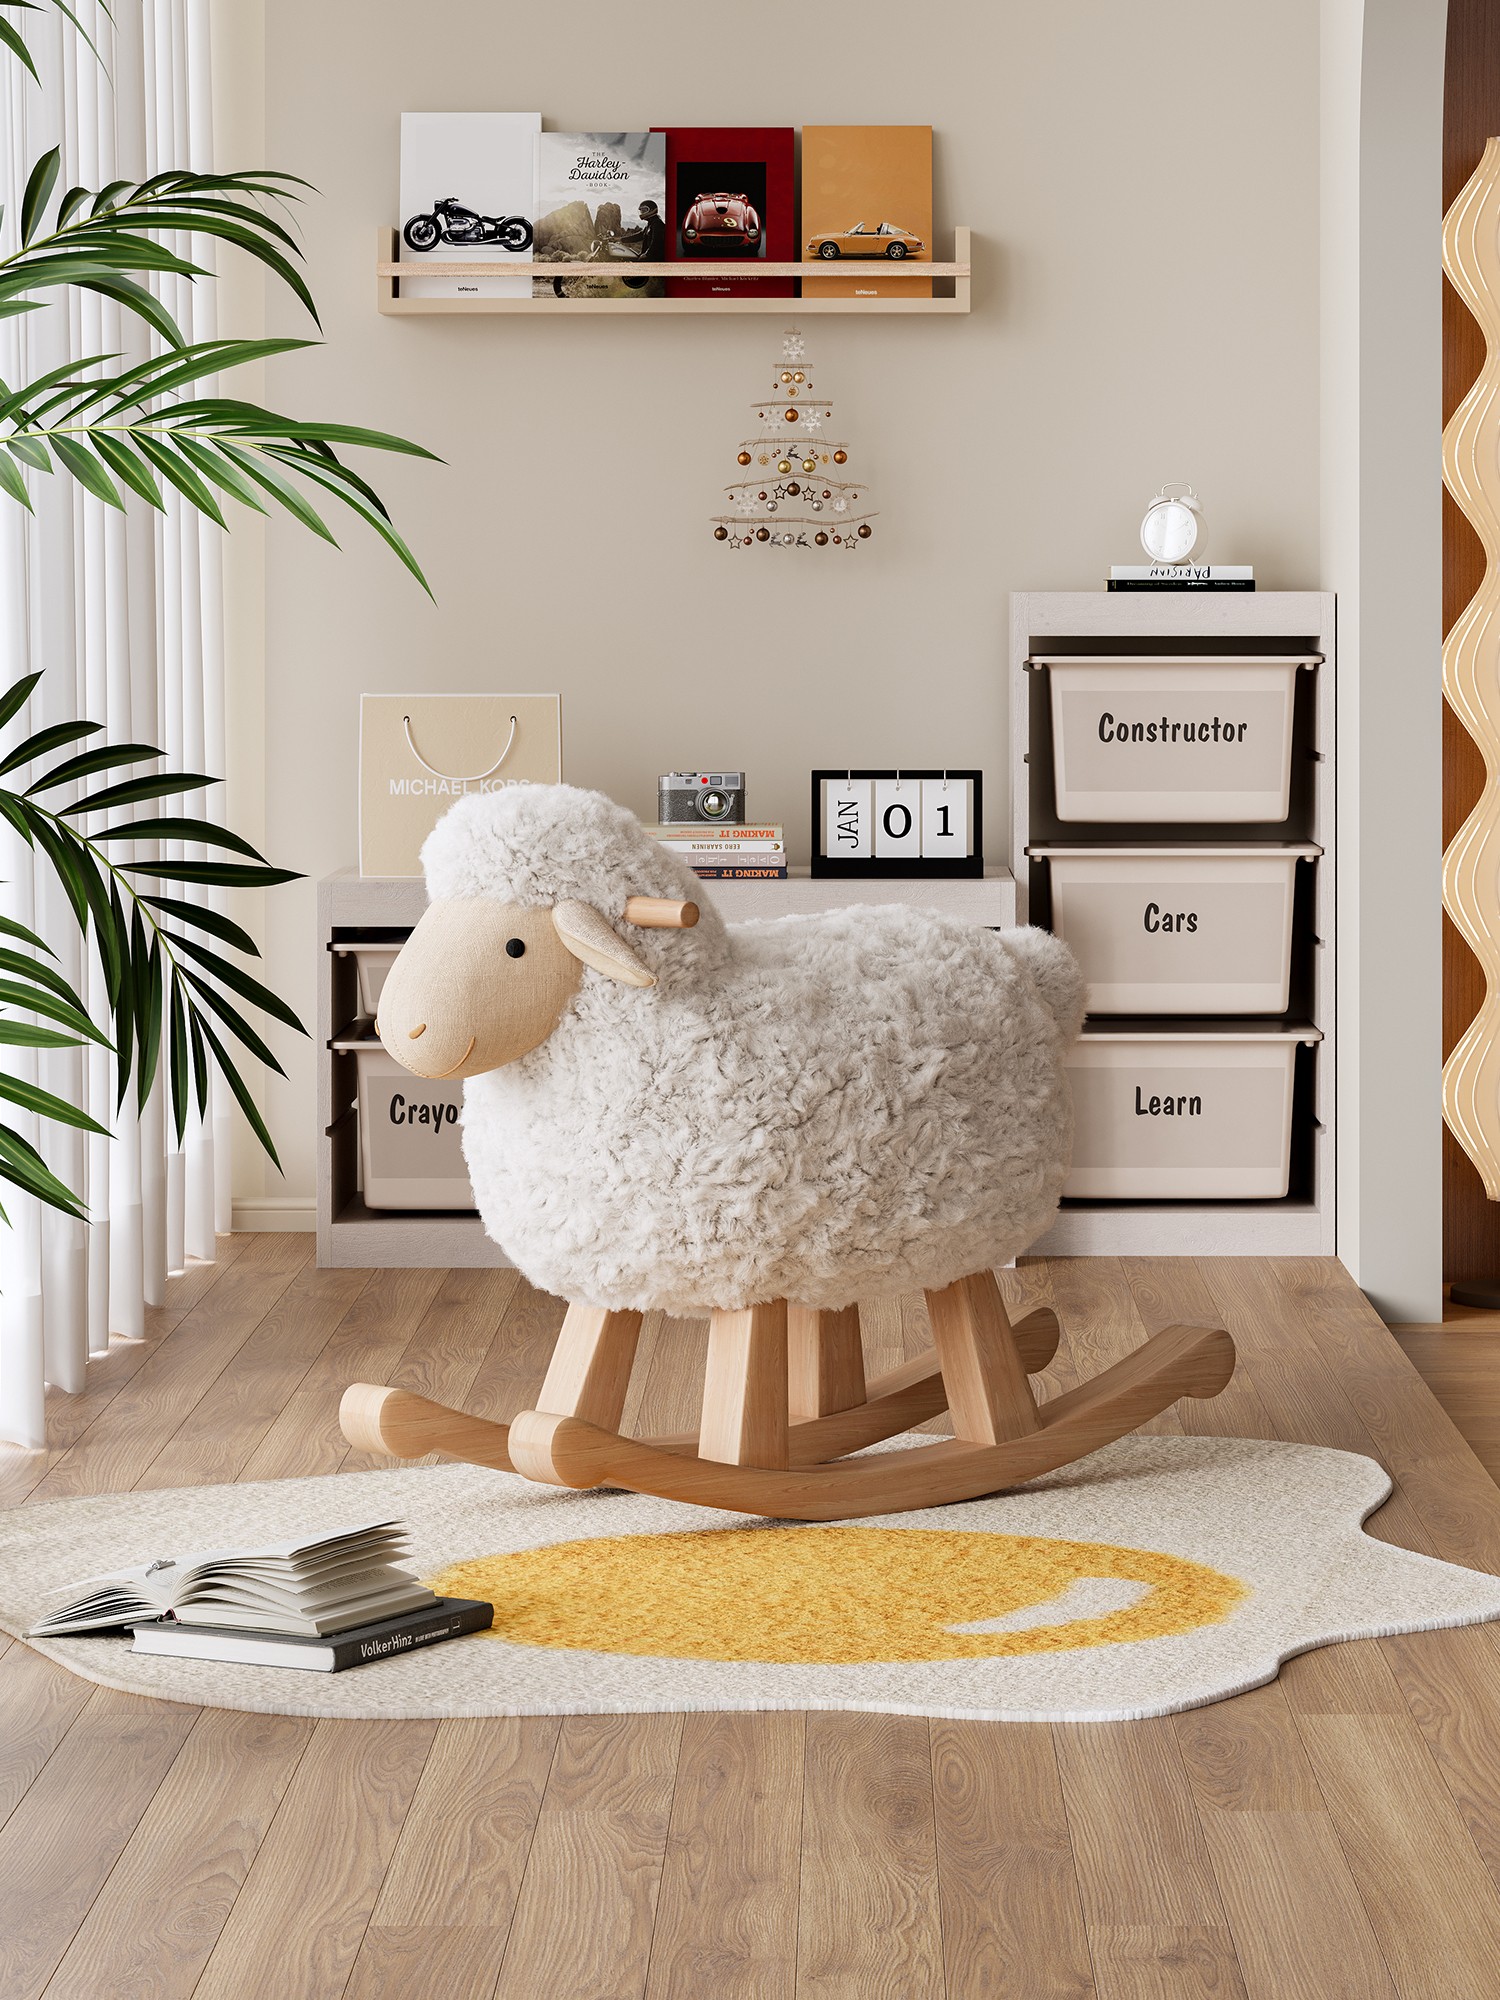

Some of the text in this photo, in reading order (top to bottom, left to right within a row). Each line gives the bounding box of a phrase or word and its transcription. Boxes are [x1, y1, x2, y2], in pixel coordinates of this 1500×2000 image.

[576, 156, 626, 173] Harley-
[568, 167, 630, 181] Davidson
[1098, 711, 1248, 743] Constructor
[389, 779, 473, 796] MICHAEL
[836, 800, 859, 849] JAN
[719, 829, 731, 838] IT
[733, 829, 775, 838] MAKING
[721, 869, 733, 878] IT
[735, 869, 779, 878] MAKING
[1143, 902, 1198, 933] Cars
[1135, 1086, 1202, 1116] Learn
[389, 1093, 464, 1134] Crayo
[360, 1634, 413, 1658] VolkerHinz
